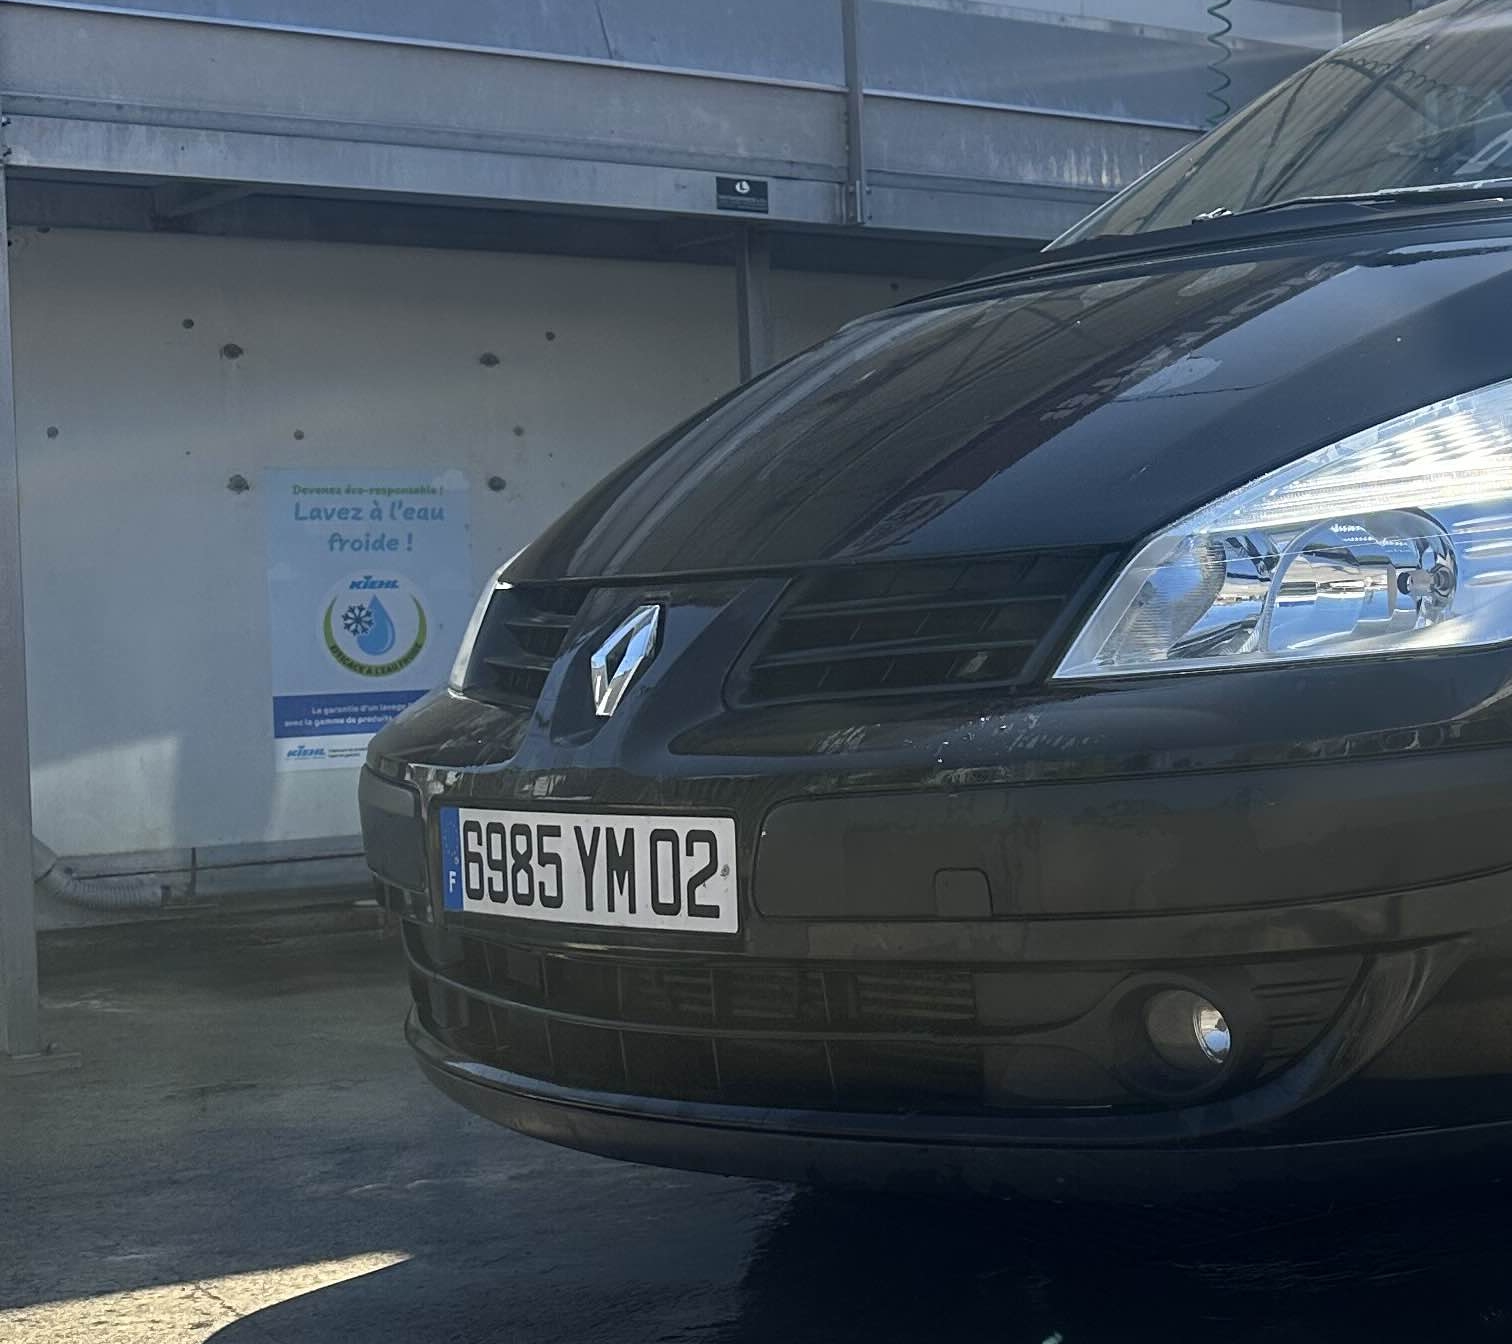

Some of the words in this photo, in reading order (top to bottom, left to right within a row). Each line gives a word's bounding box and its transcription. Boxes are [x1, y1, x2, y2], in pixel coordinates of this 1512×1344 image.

[294, 501, 363, 521] Lavez
[369, 499, 383, 521] à
[389, 500, 445, 521] l'eau
[328, 532, 399, 552] froide
[406, 532, 413, 551] !
[463, 820, 564, 909] 6985
[573, 825, 637, 914] YM
[650, 828, 720, 919] 02
[448, 870, 457, 894] F
